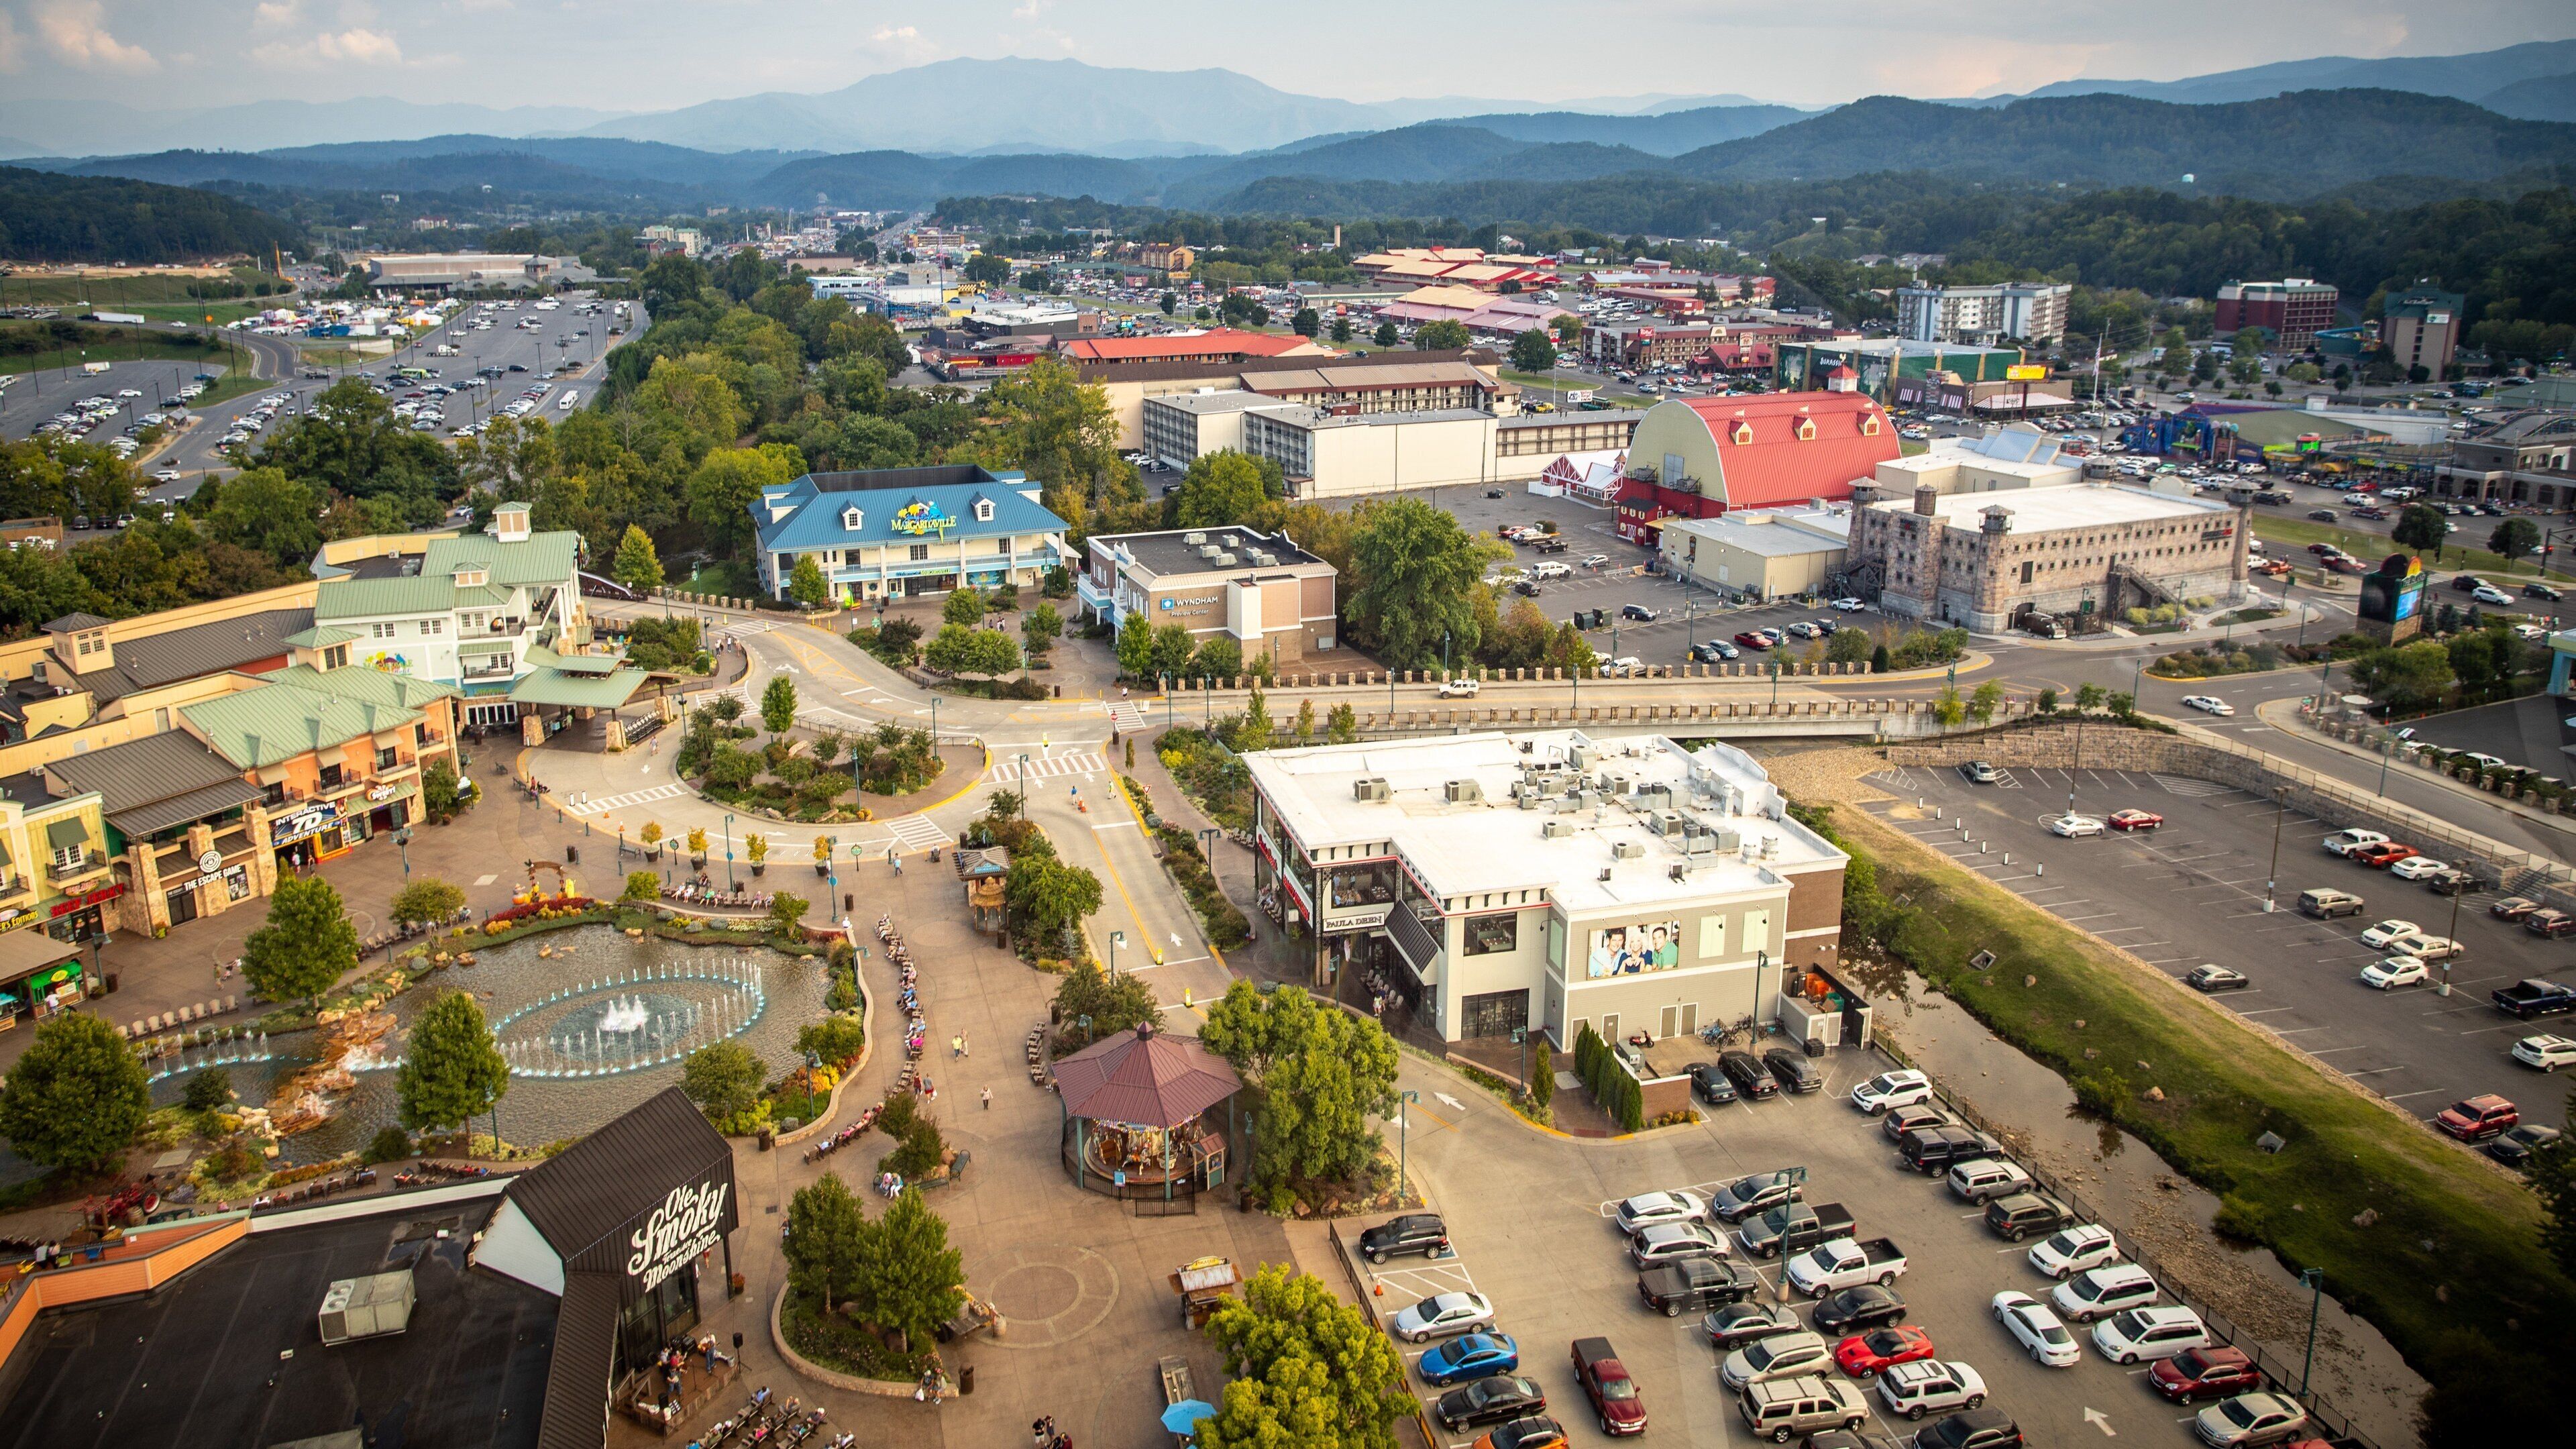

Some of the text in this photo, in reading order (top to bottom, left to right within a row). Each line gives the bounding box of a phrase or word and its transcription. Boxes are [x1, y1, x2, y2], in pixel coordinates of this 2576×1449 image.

[1177, 596, 1218, 606] WYNDHAM
[276, 802, 335, 826] INTERACTIVE
[292, 812, 323, 835] 7D
[282, 822, 333, 845] ADVENTURE
[184, 879, 198, 891] THE
[198, 870, 223, 886] ESCAPE
[223, 864, 241, 877] GAME
[1326, 916, 1382, 928] PAULA DEEN
[665, 1185, 699, 1221] Ole
[628, 1181, 728, 1275] Smoky
[643, 1230, 720, 1293] Moonshine
